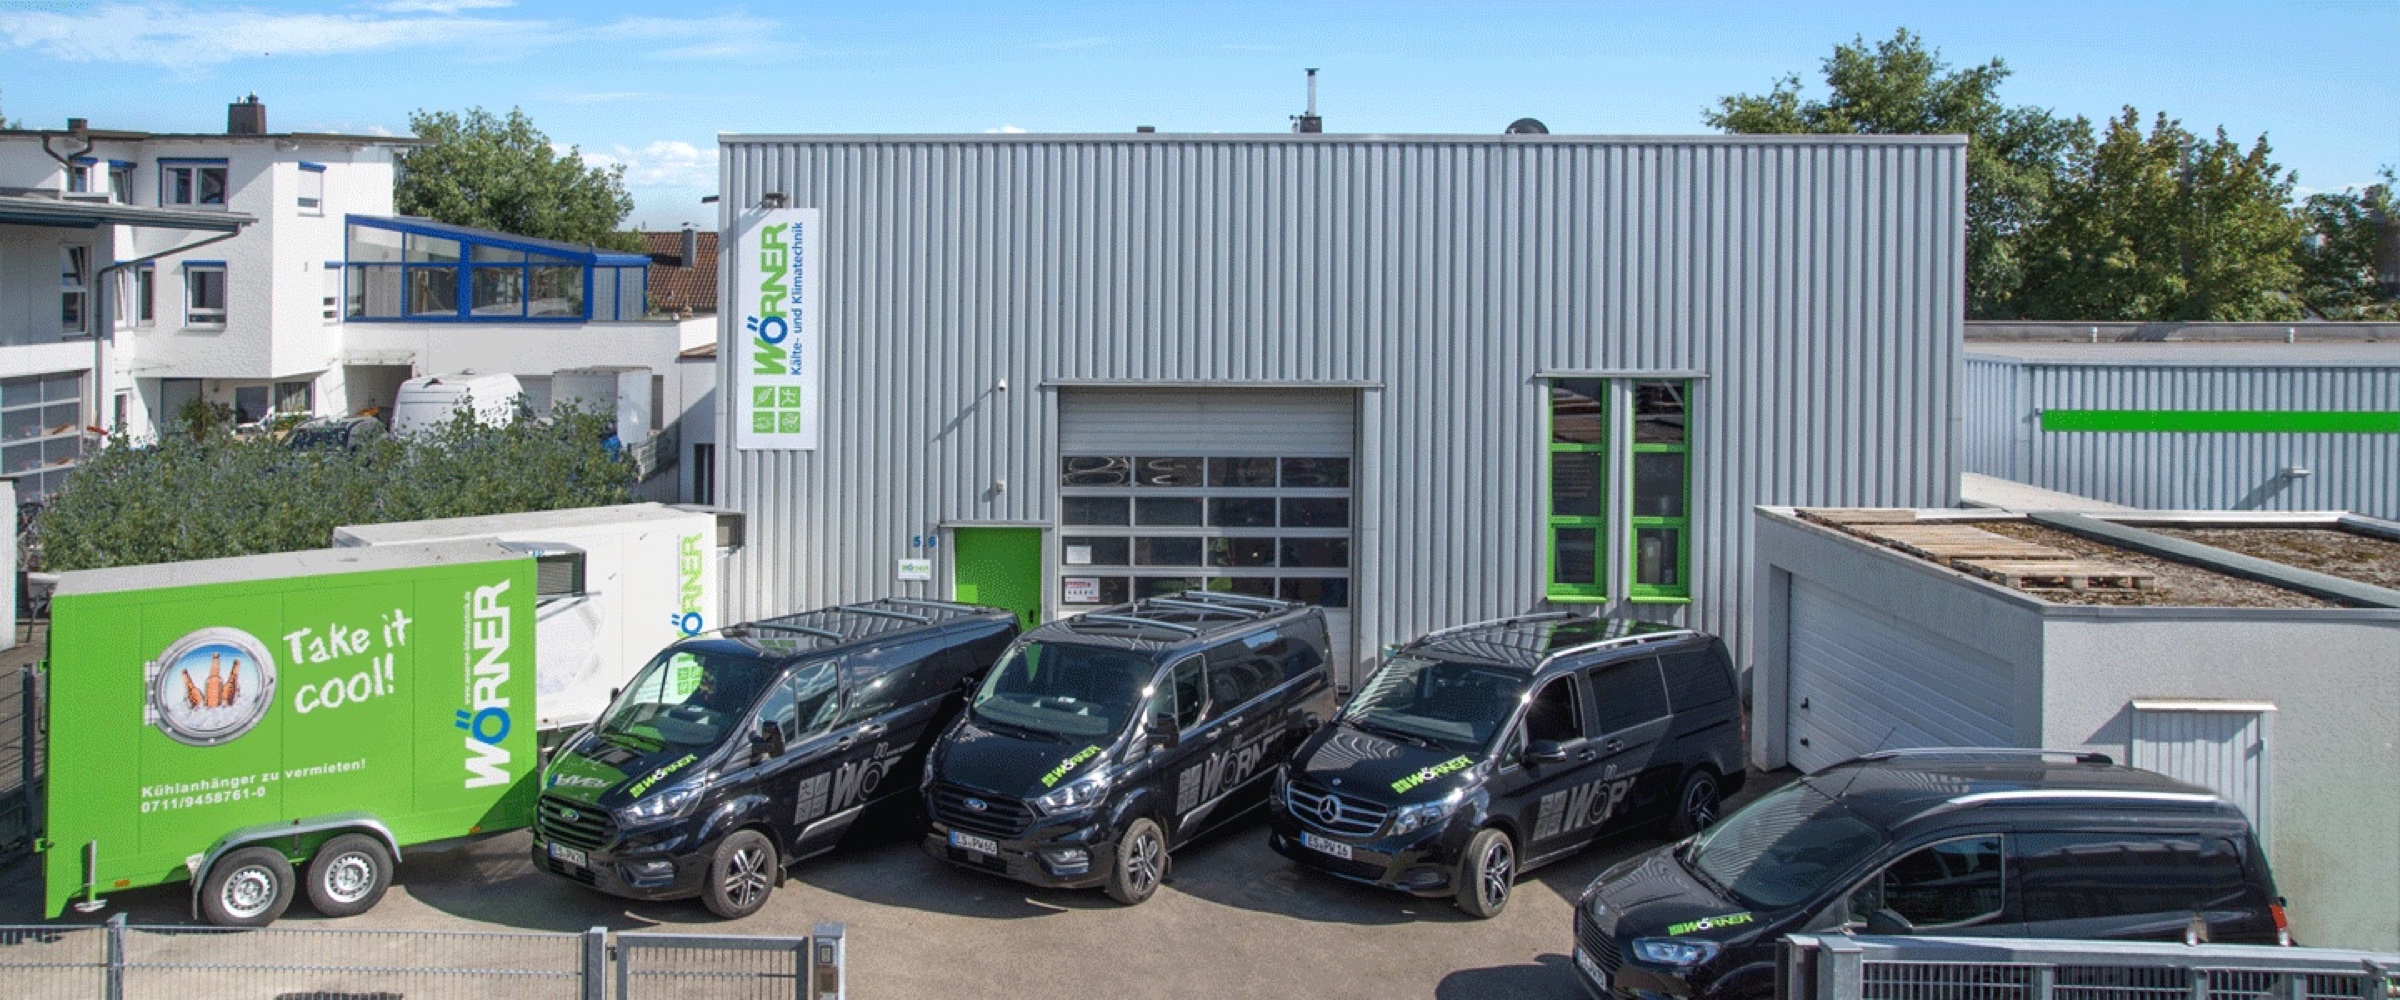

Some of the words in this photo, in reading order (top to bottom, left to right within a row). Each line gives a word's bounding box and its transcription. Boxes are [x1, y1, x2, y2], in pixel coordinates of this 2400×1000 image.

[791, 221, 803, 304] Klimatechnik
[746, 221, 788, 375] WÖRNER
[793, 308, 804, 333] und
[791, 337, 803, 375] Kälte-
[283, 622, 371, 664] Take
[381, 608, 413, 648] it
[294, 652, 395, 714] cool!
[454, 578, 511, 789] WÖRNER
[141, 773, 256, 798] Kühlanhänger
[261, 771, 279, 782] zu
[284, 758, 367, 779] vermieten!
[641, 753, 698, 788] WÖRNER
[1052, 744, 1101, 775] WÖRNER
[1409, 754, 1475, 787] WÖRNER
[141, 786, 266, 813] 0711/9458761-0
[1682, 911, 1753, 933] WÖRNER
